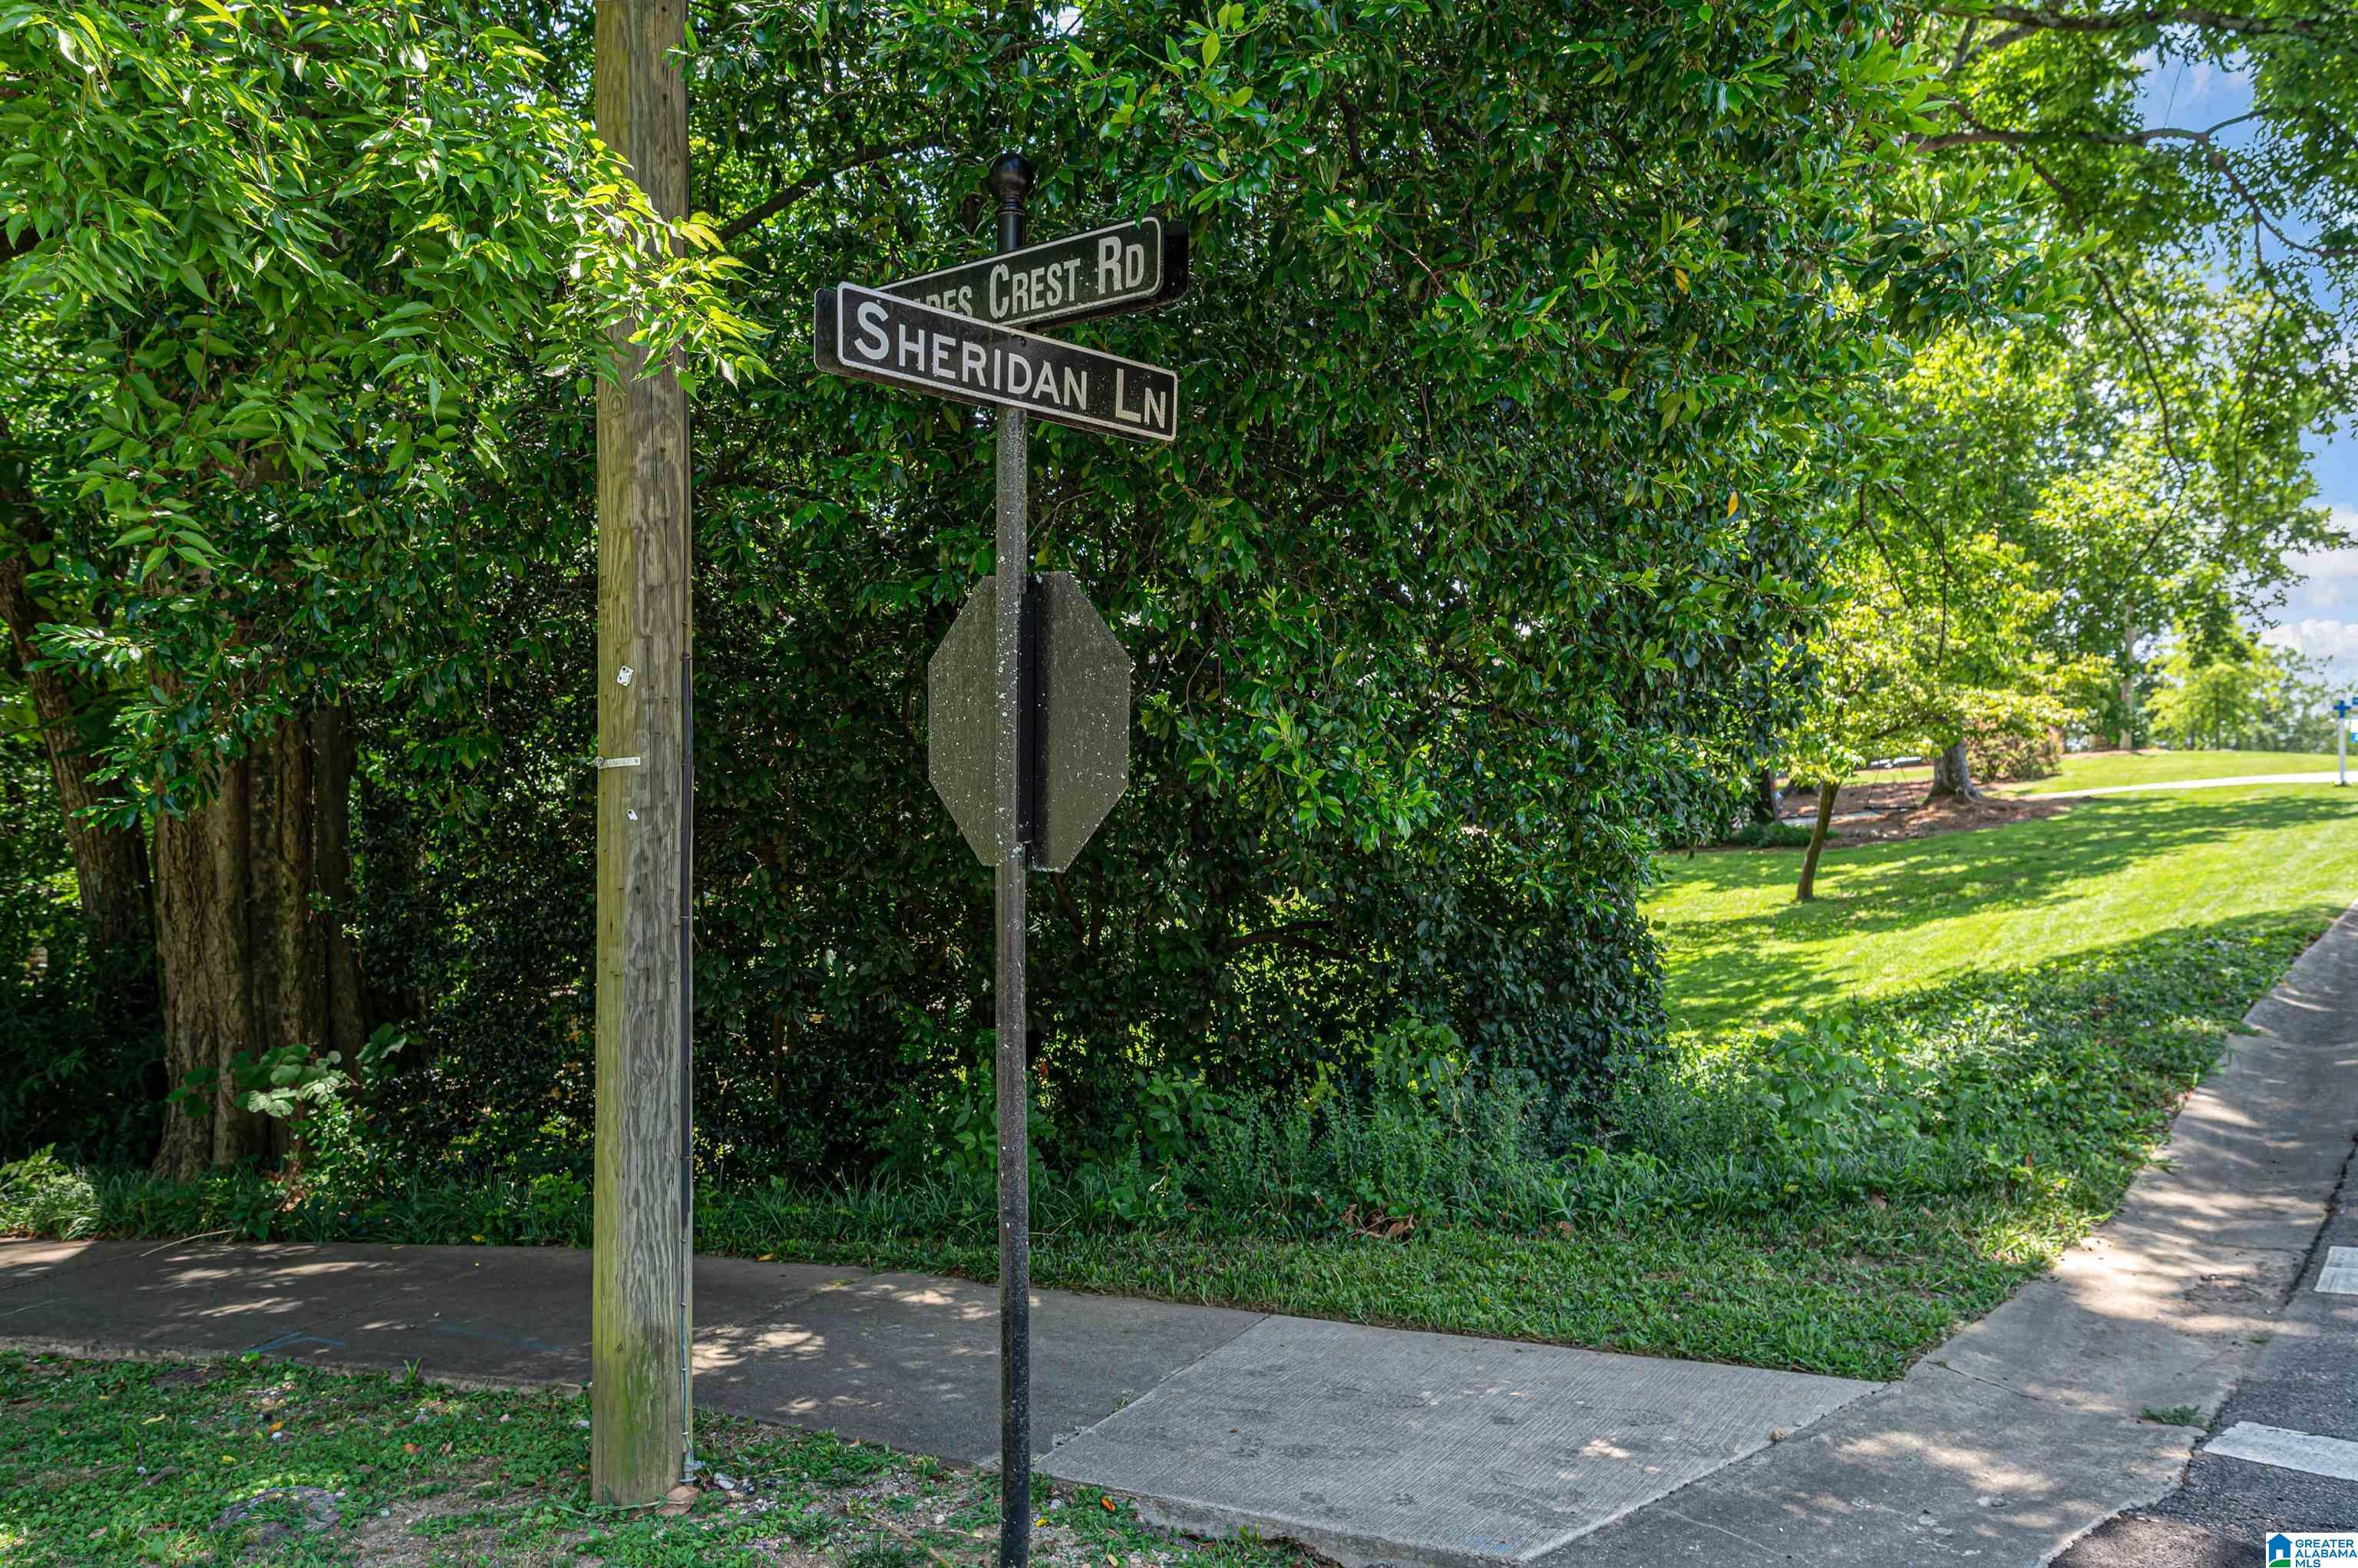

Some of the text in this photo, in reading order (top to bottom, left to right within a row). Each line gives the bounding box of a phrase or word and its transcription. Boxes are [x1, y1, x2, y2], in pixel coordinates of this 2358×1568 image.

[989, 257, 1081, 319] CREST
[1098, 236, 1144, 295] RD
[854, 301, 1165, 429] SHERIDAN LN
